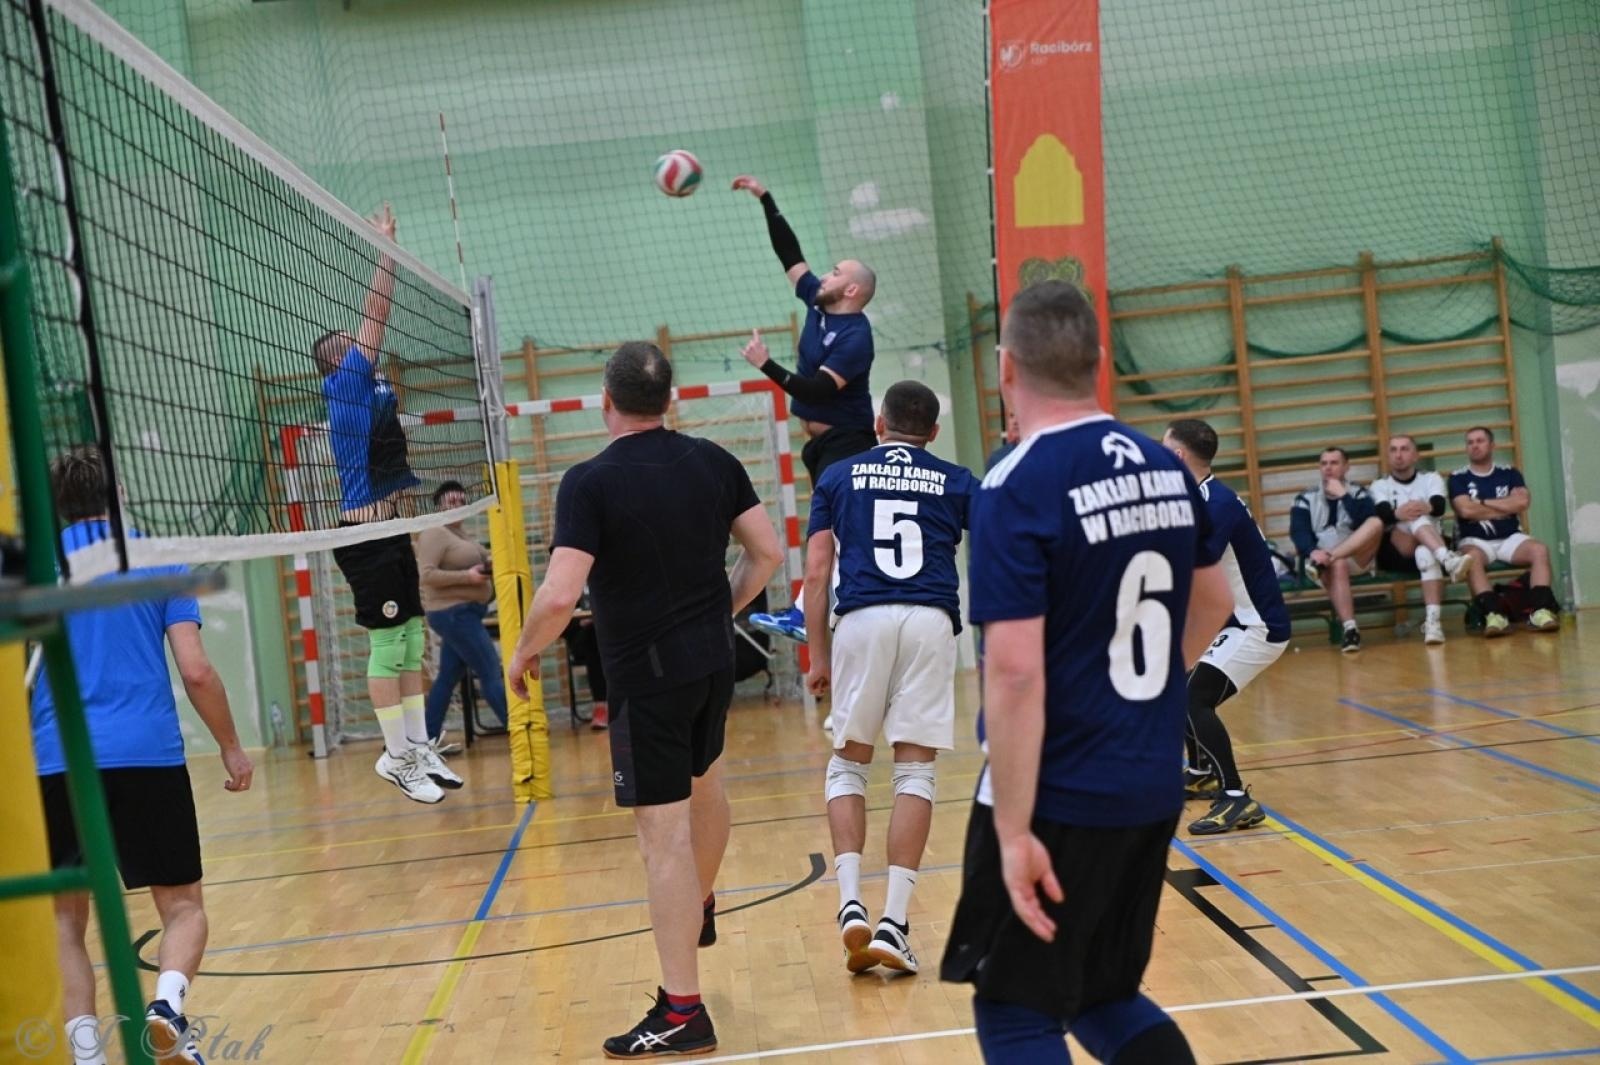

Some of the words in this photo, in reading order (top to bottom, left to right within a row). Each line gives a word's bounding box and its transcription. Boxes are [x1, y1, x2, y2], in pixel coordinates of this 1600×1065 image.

[1030, 40, 1092, 54] Racibórz
[851, 463, 901, 477] ZAKŁAD
[903, 465, 947, 485] KARNY
[852, 477, 867, 491] W
[869, 476, 945, 496] RACIBORZU
[1068, 474, 1140, 516] ZAKŁAD
[873, 499, 924, 579] 5
[1080, 513, 1108, 544] W
[1108, 550, 1174, 701] 6
